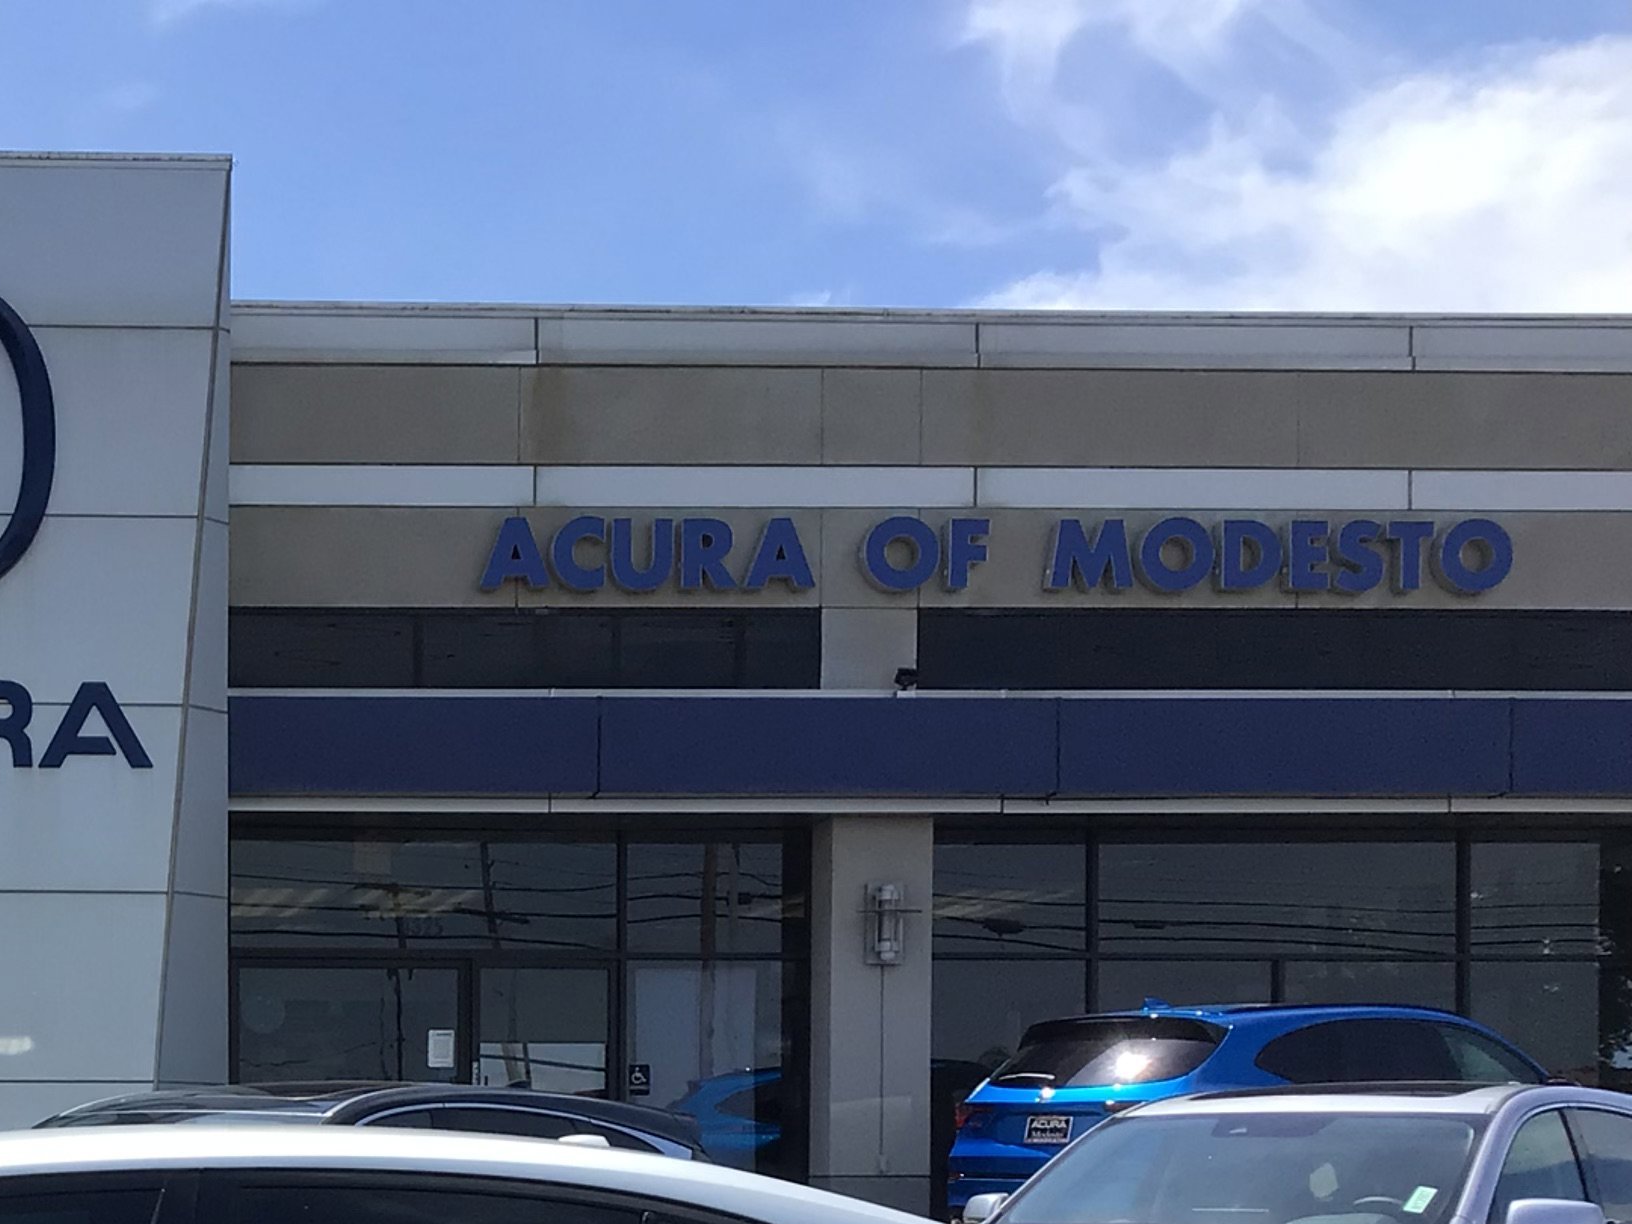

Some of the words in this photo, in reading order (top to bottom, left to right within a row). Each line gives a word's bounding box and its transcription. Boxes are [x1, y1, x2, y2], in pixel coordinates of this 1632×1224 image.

[479, 515, 816, 592] ACURA
[861, 515, 991, 592] OF
[1045, 516, 1514, 594] MODESTO
[1031, 1120, 1067, 1128] ACURA
